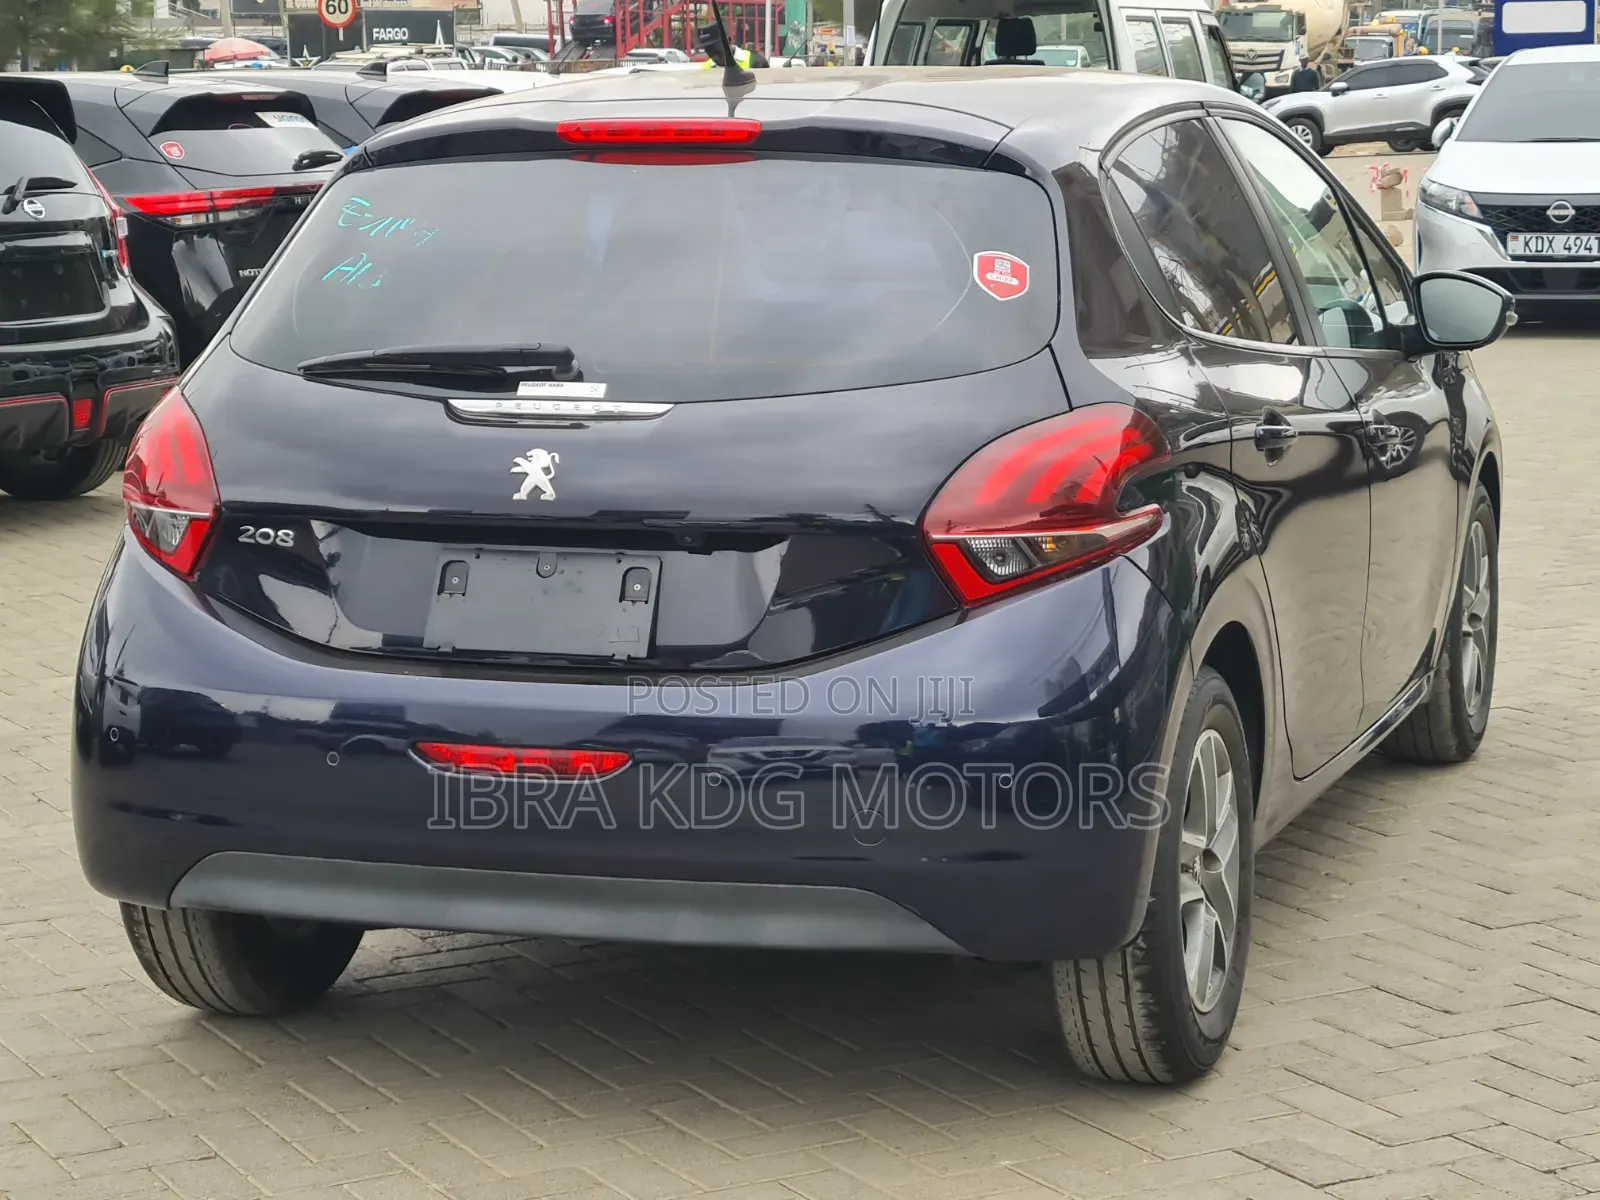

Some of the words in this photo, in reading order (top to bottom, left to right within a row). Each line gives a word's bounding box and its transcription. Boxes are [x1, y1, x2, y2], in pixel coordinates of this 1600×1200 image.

[325, 0, 349, 15] 60
[372, 27, 409, 41] FARGO
[1523, 235, 1556, 254] KDX
[238, 267, 264, 278] NOT
[495, 402, 622, 413] PEUGEOT
[238, 525, 295, 547] 208
